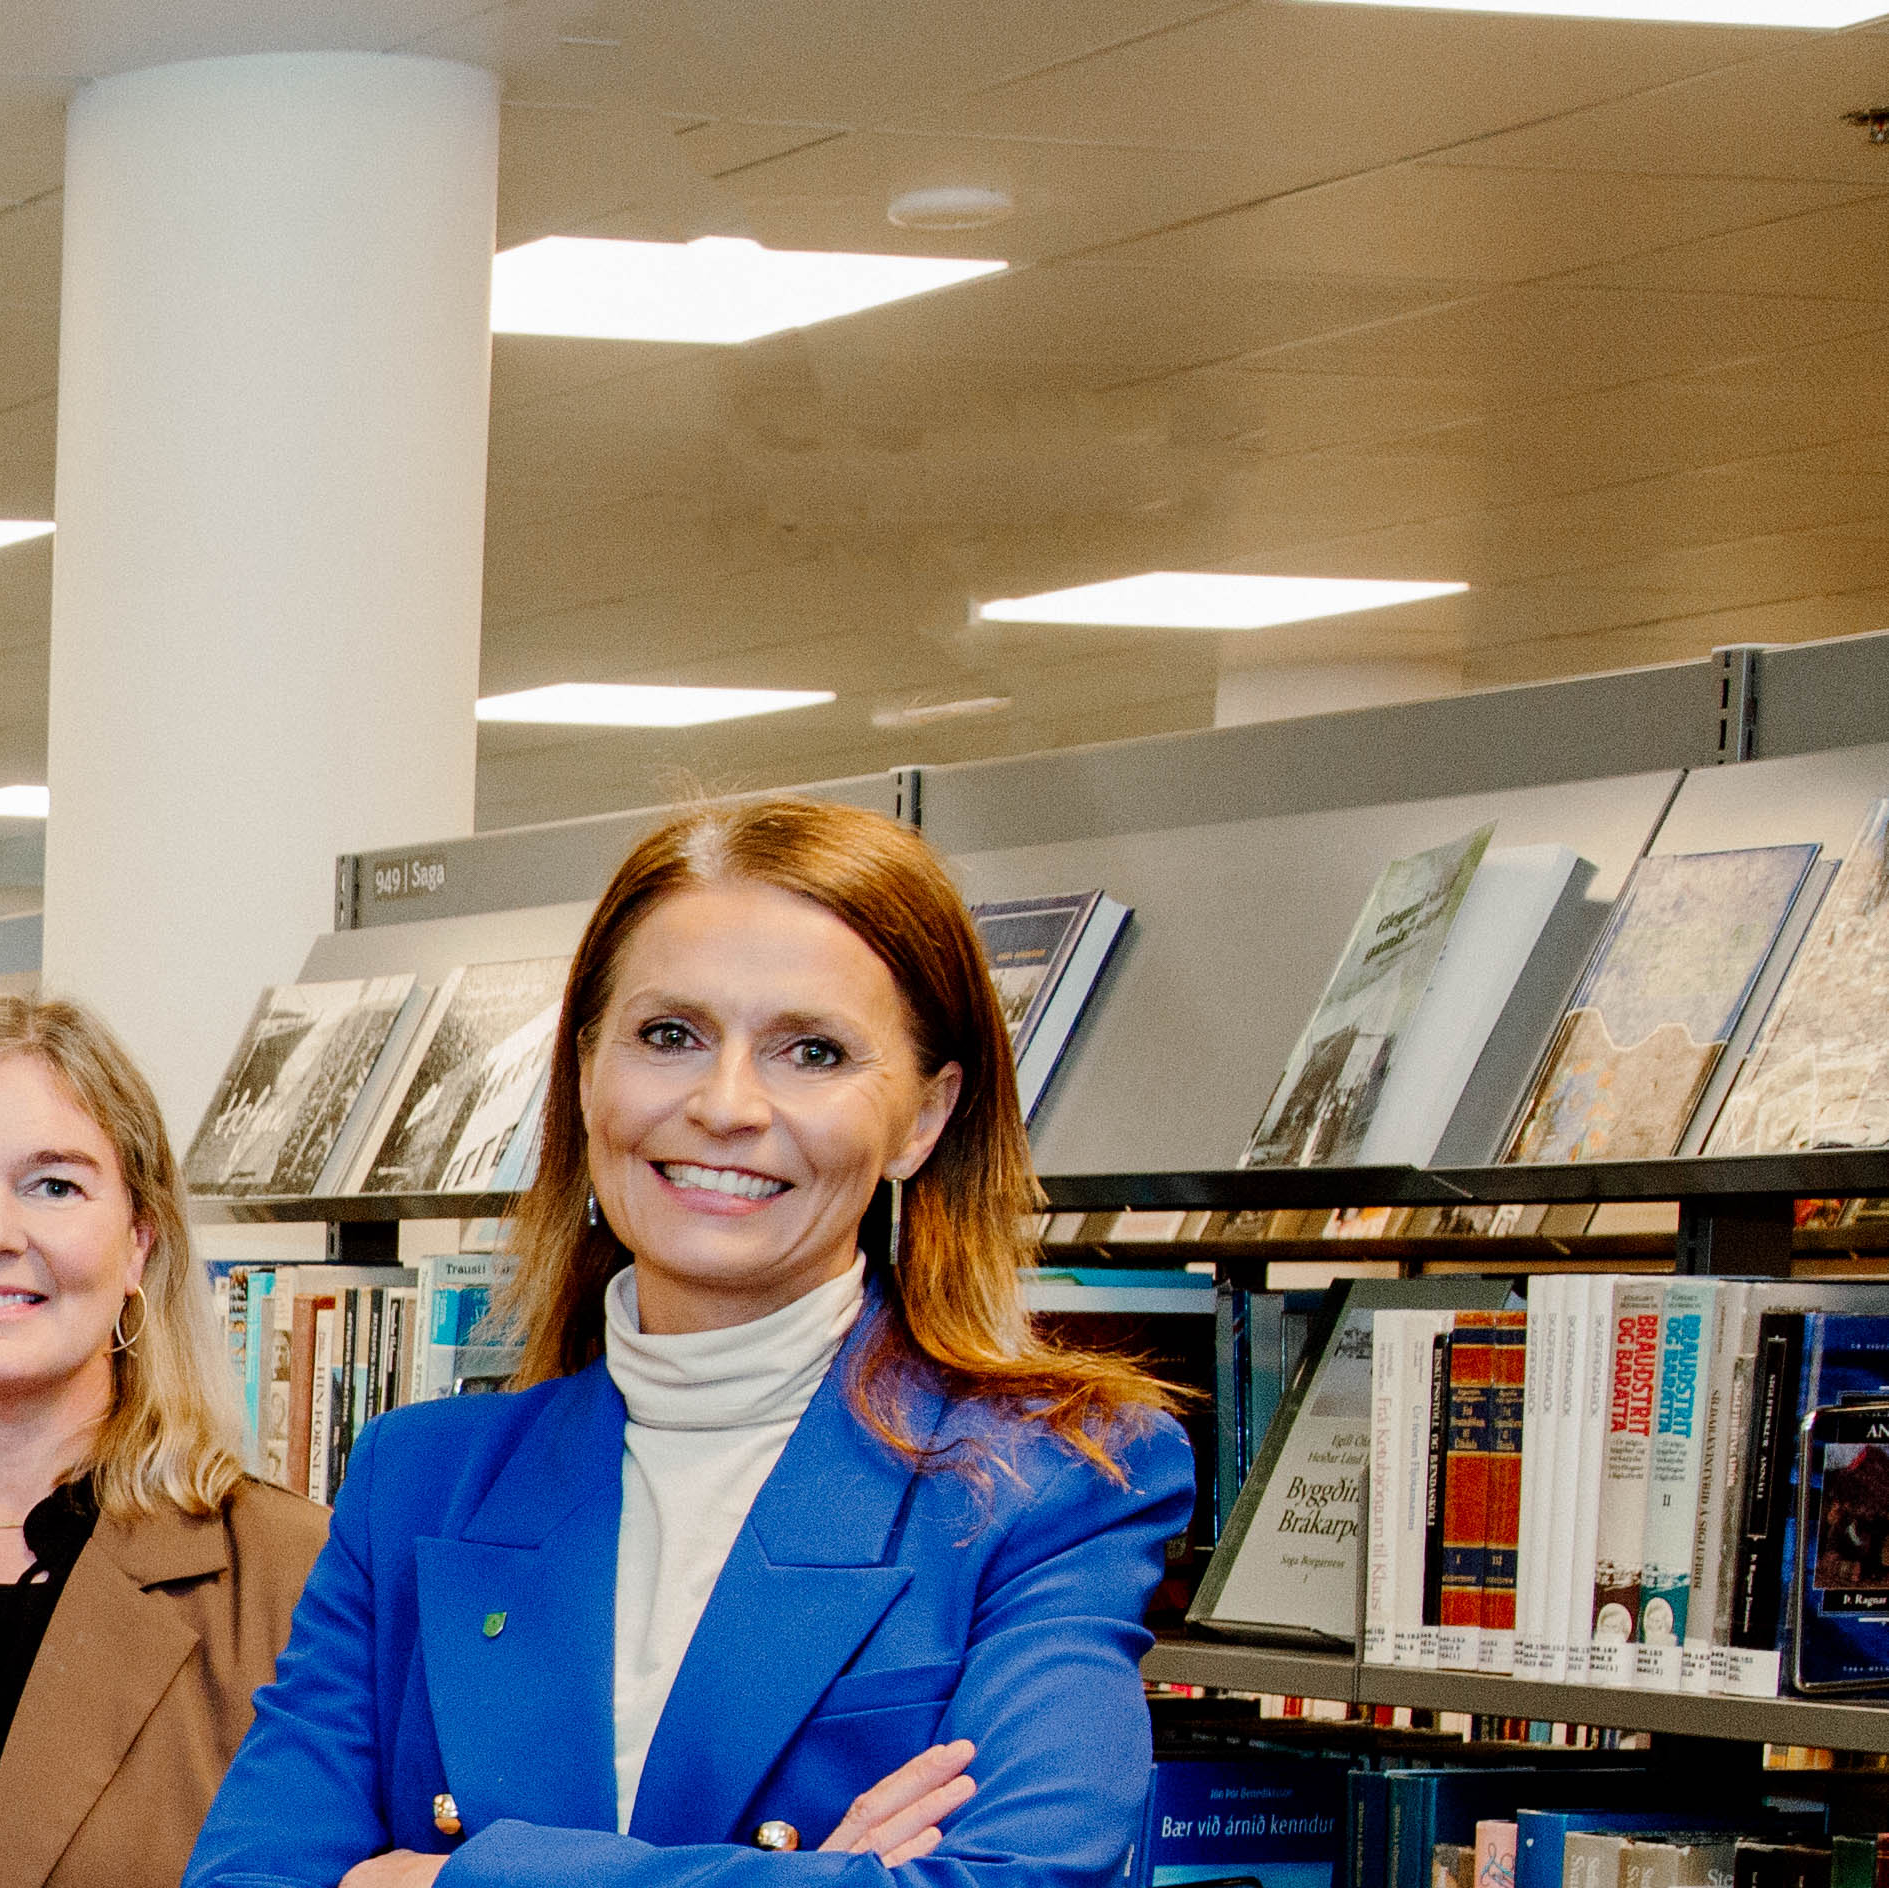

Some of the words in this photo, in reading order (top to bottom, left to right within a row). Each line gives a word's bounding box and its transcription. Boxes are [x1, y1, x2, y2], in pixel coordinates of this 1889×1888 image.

[375, 869, 401, 895] 949
[411, 862, 445, 890] Saga
[1161, 1817, 1192, 1838] Bær
[1197, 1816, 1221, 1837] við
[1225, 1815, 1266, 1837] árnið
[1270, 1815, 1335, 1836] kenndur
